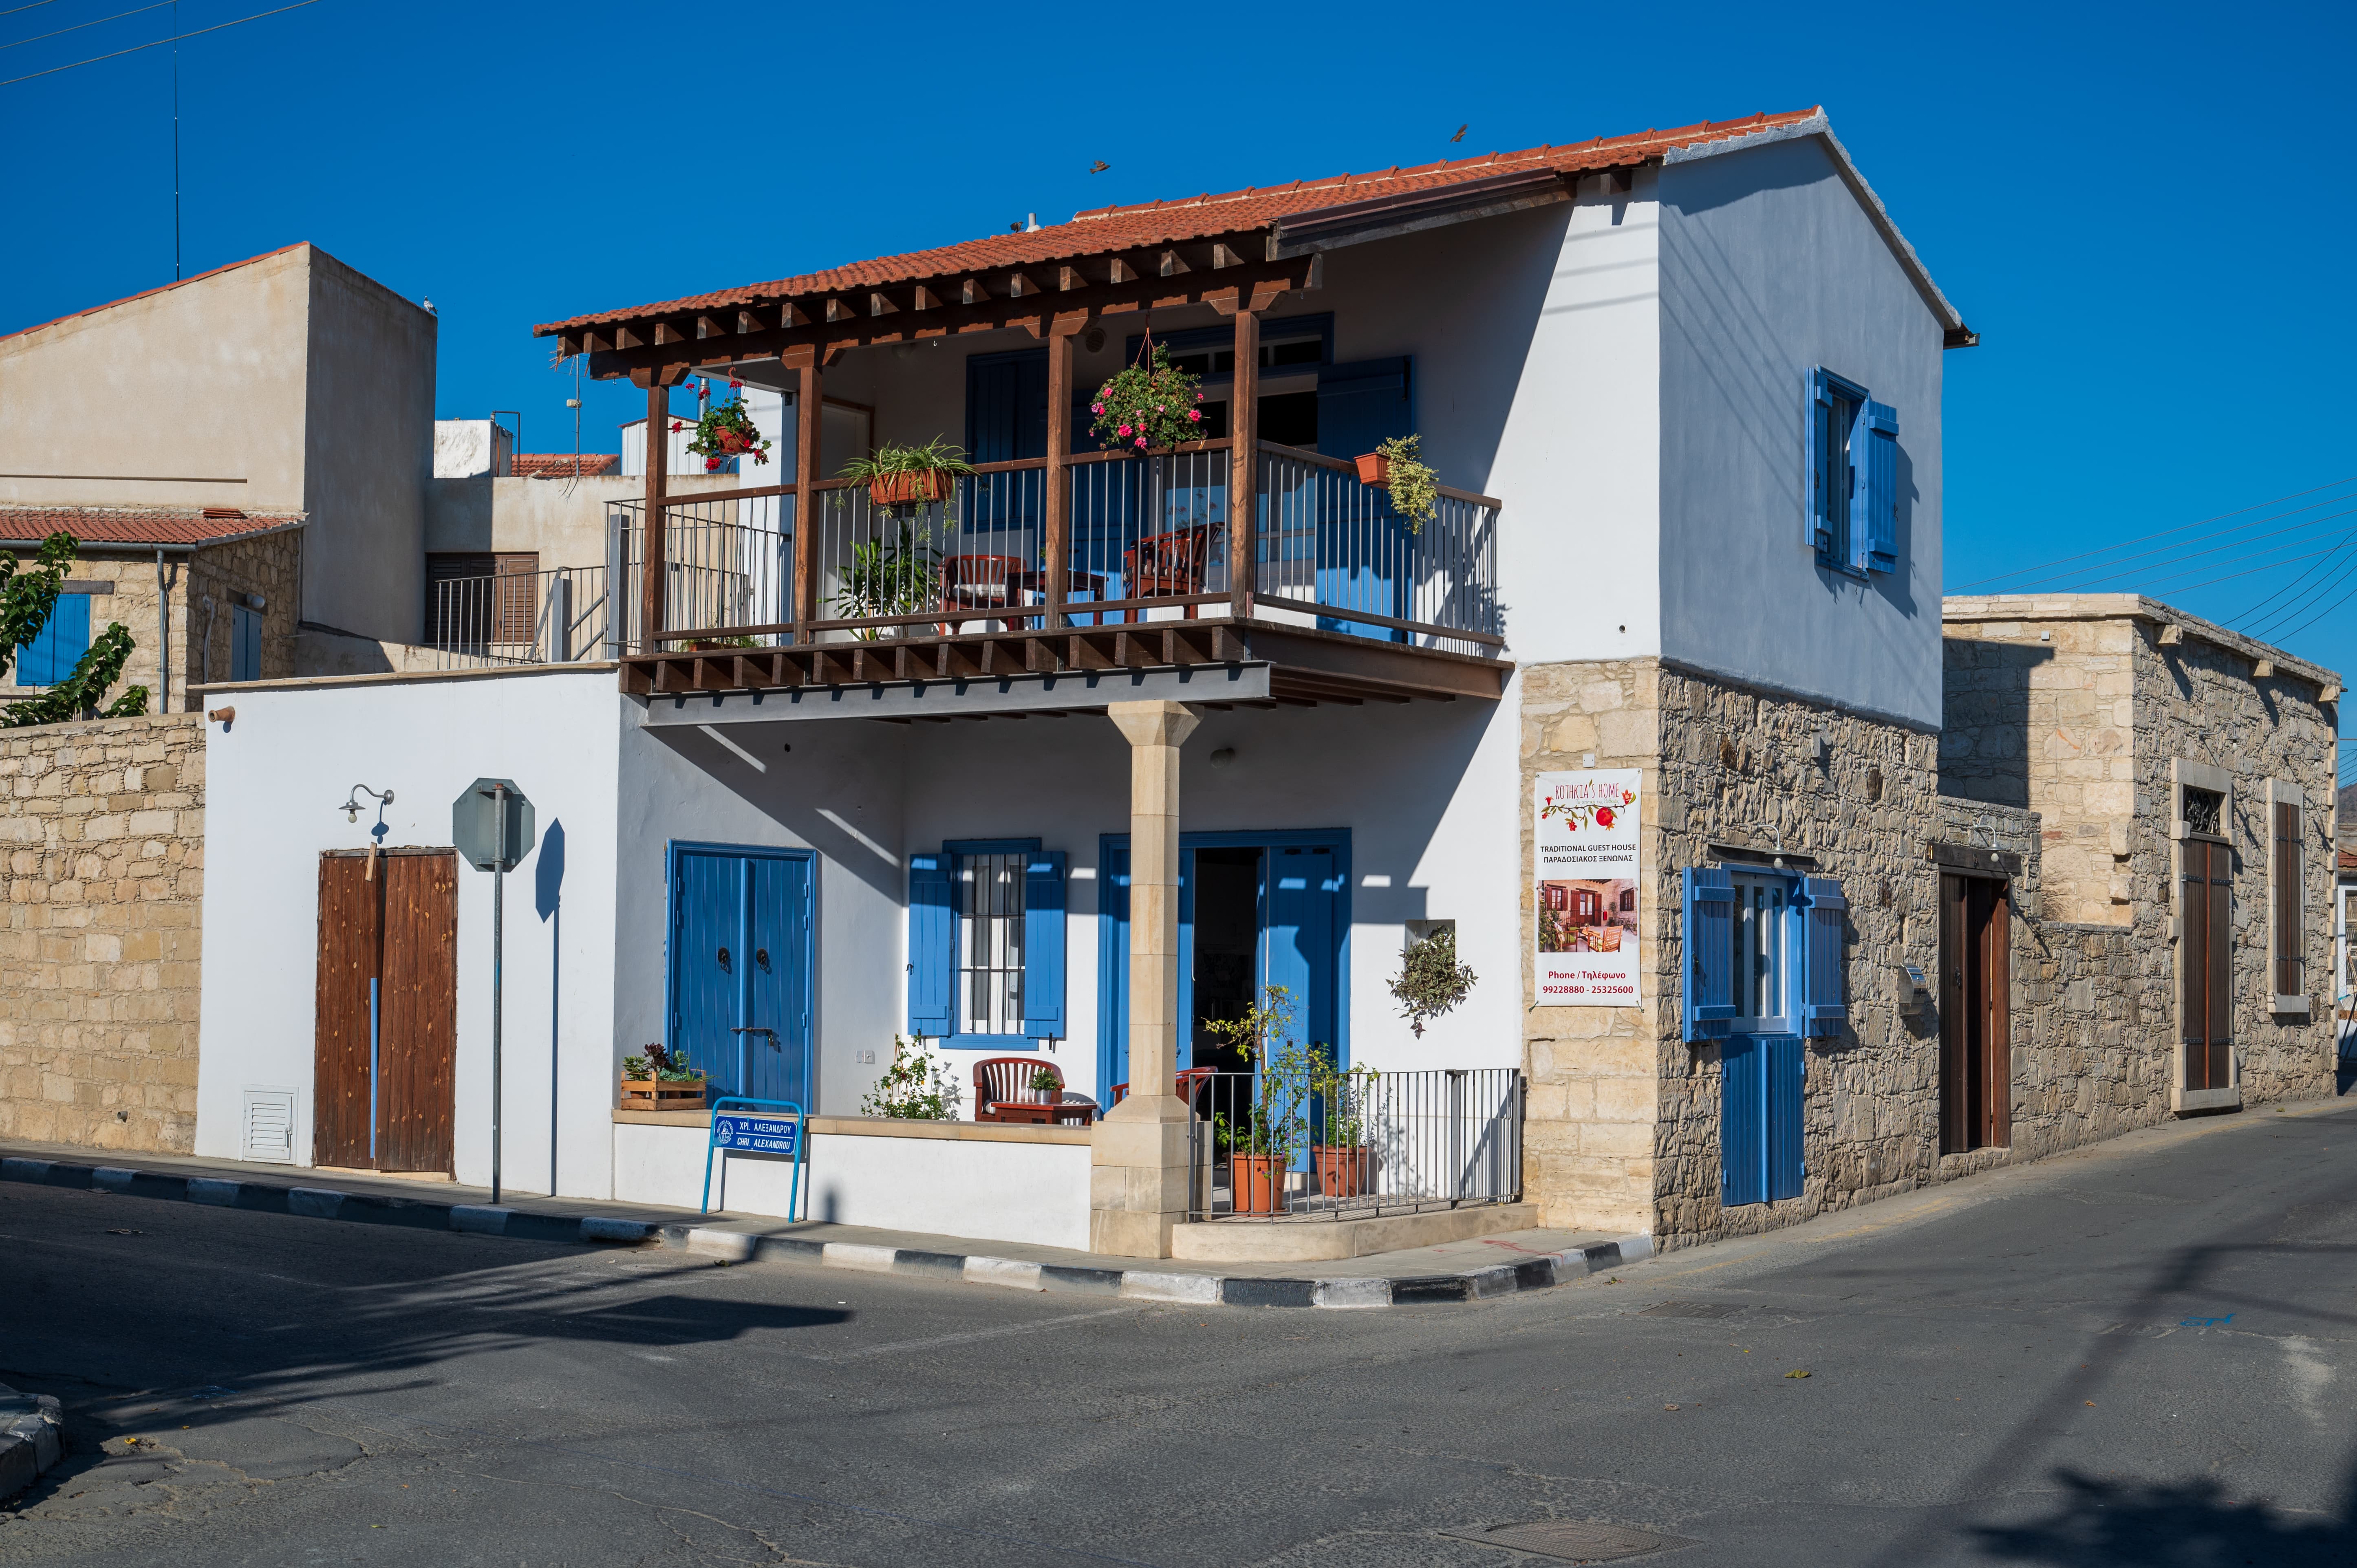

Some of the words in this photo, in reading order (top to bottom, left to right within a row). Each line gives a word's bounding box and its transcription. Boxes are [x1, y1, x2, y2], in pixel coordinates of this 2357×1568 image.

[1556, 778, 1595, 799] ROTHKIA'S
[1598, 783, 1619, 798] HOME
[1548, 971, 1575, 979] Phone
[1581, 971, 1626, 981] Τηλέφωνο
[754, 1123, 792, 1134] ΑΛΕΞΑΝΔΡΟΥ
[737, 1137, 750, 1146] CHRI.
[753, 1139, 790, 1150] ALEXANDROU
